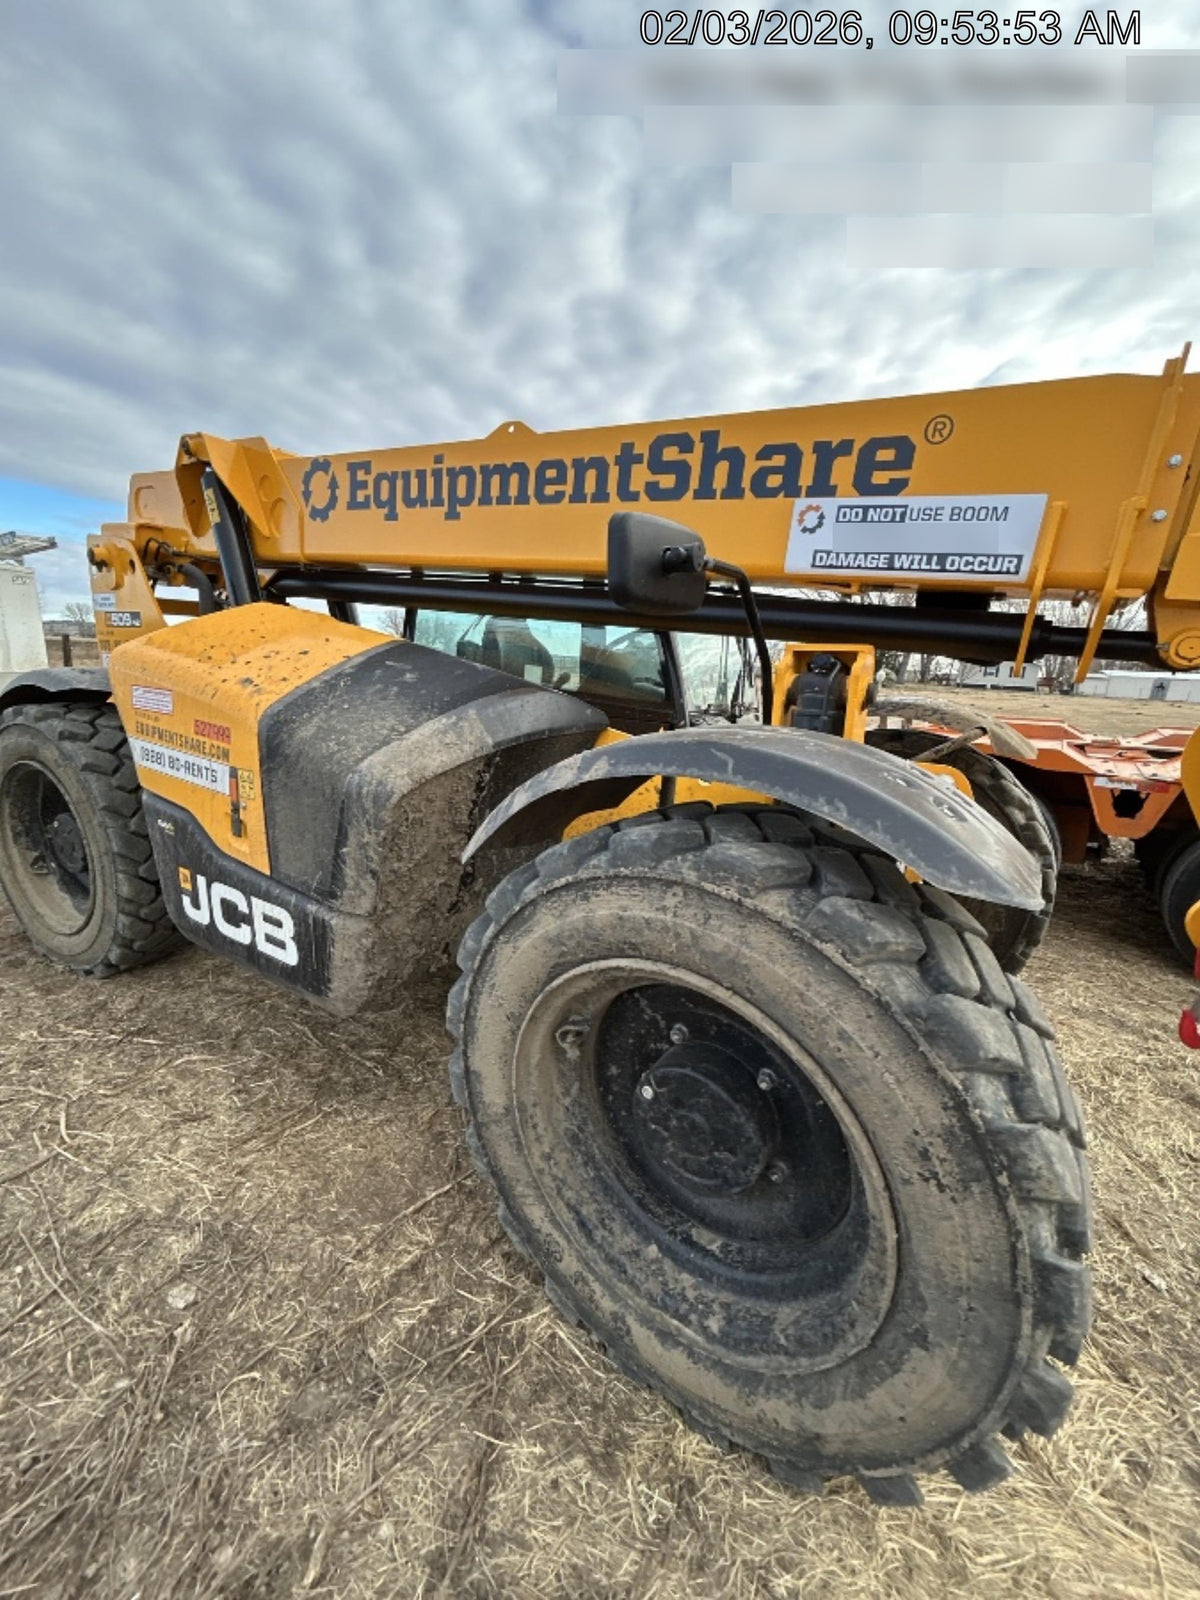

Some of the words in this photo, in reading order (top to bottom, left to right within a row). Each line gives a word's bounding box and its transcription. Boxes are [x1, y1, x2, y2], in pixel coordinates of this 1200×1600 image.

[346, 429, 917, 522] EquipmentShare
[837, 507, 865, 523] DO
[866, 507, 907, 523] NOT
[908, 506, 944, 522] USE
[949, 506, 1009, 522] BOOM
[814, 551, 889, 568] DAMAGE
[893, 554, 941, 570] WILL
[945, 555, 1019, 573] OCCUR
[181, 874, 299, 966] JCB
